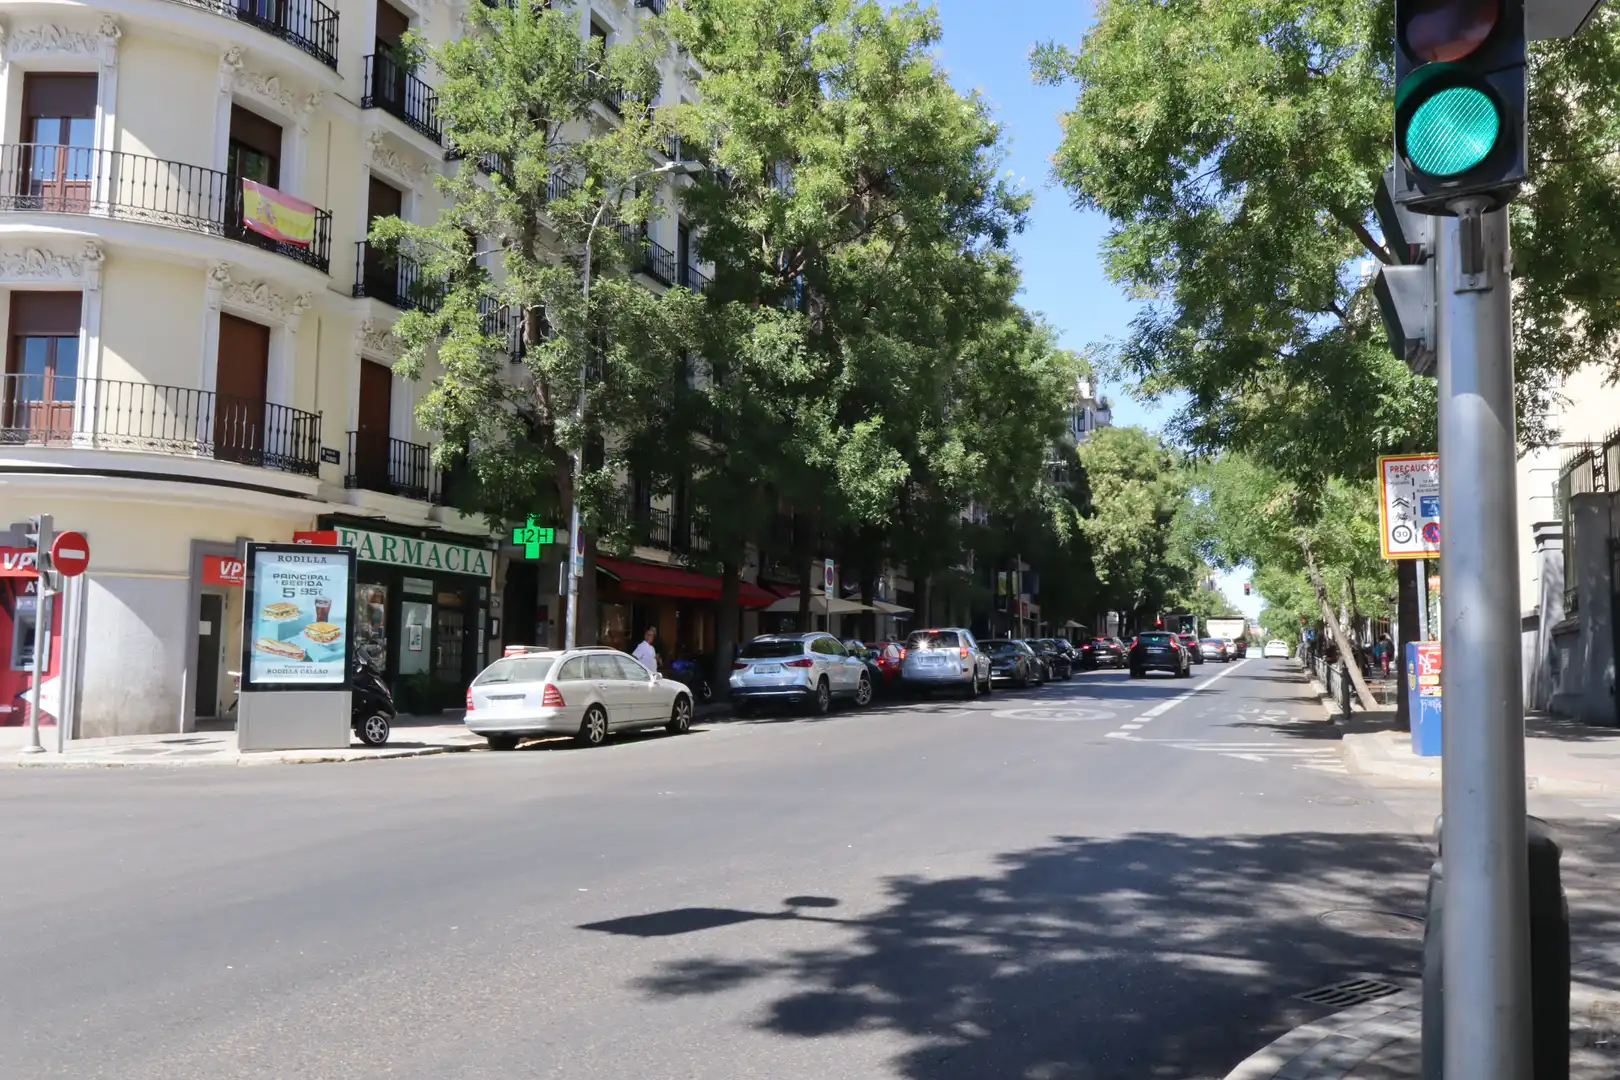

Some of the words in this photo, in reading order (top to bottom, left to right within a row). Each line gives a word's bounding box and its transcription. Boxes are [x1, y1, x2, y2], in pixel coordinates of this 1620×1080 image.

[520, 528, 548, 543] 12H
[1396, 530, 1409, 538] 30
[277, 555, 327, 563] RODILLA
[340, 529, 488, 575] FARMACIA
[4, 552, 38, 569] VP
[220, 560, 245, 576] VP
[272, 573, 331, 581] PRINCIPAL
